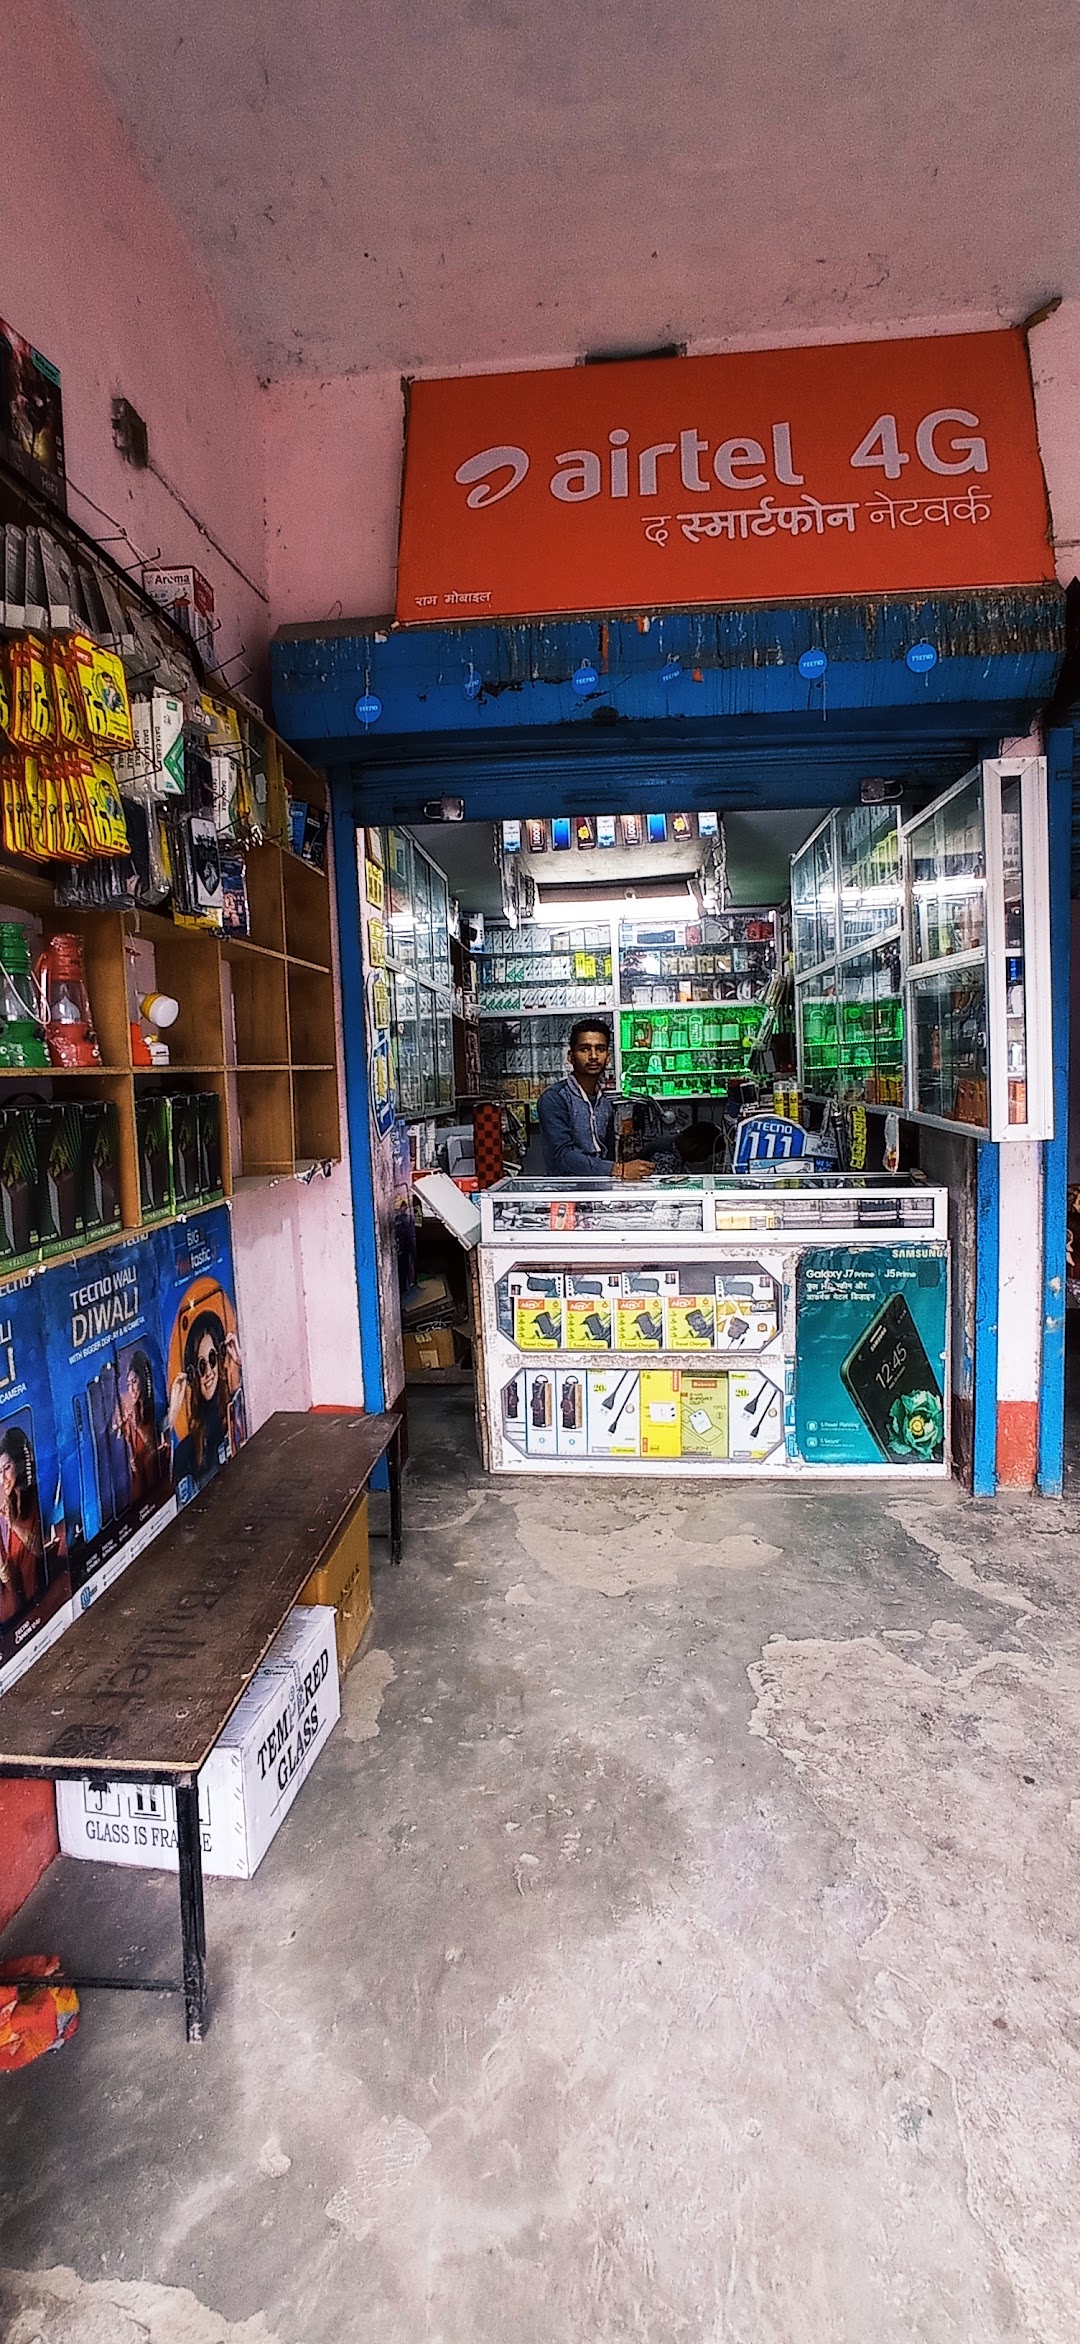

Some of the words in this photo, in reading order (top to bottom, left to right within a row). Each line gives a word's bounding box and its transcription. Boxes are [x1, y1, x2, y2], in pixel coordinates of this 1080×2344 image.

[550, 421, 805, 503] airtel
[850, 407, 990, 480] 4G
[641, 515, 672, 547] द
[676, 493, 861, 544] स्मार्टफोन
[865, 485, 993, 531] नेटवर्क
[155, 574, 190, 585] Aroma
[415, 595, 439, 607] राम
[444, 590, 492, 605] मोबाइल
[749, 1131, 793, 1159] 111
[753, 1120, 793, 1134] TECNO
[69, 1276, 112, 1310] TECNO
[112, 1265, 138, 1290] WALI
[805, 1269, 842, 1281] Galaxy
[72, 1286, 139, 1349] DIWALI
[875, 1341, 907, 1389] 12:45
[277, 1703, 319, 1791] GLASS
[86, 1820, 130, 1844] GLASS
[134, 1825, 148, 1846] IS
[151, 1827, 213, 1853] FRAE
